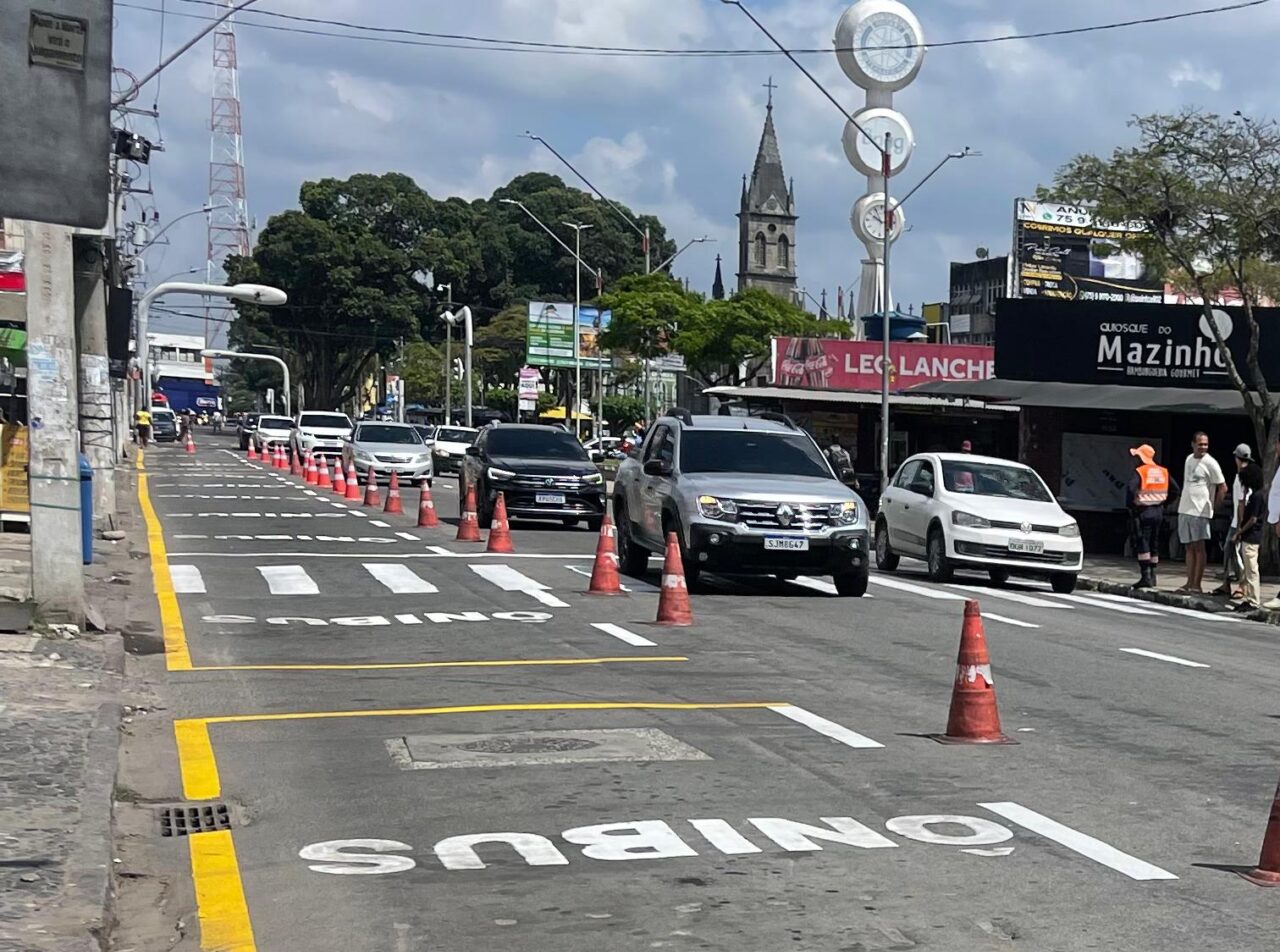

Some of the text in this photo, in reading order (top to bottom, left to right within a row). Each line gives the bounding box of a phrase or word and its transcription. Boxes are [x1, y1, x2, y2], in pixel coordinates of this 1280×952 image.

[1099, 322, 1172, 335] QUIOSQUE DO
[1097, 334, 1232, 368] Mazinho
[297, 813, 1016, 876] ÔNIBUS
